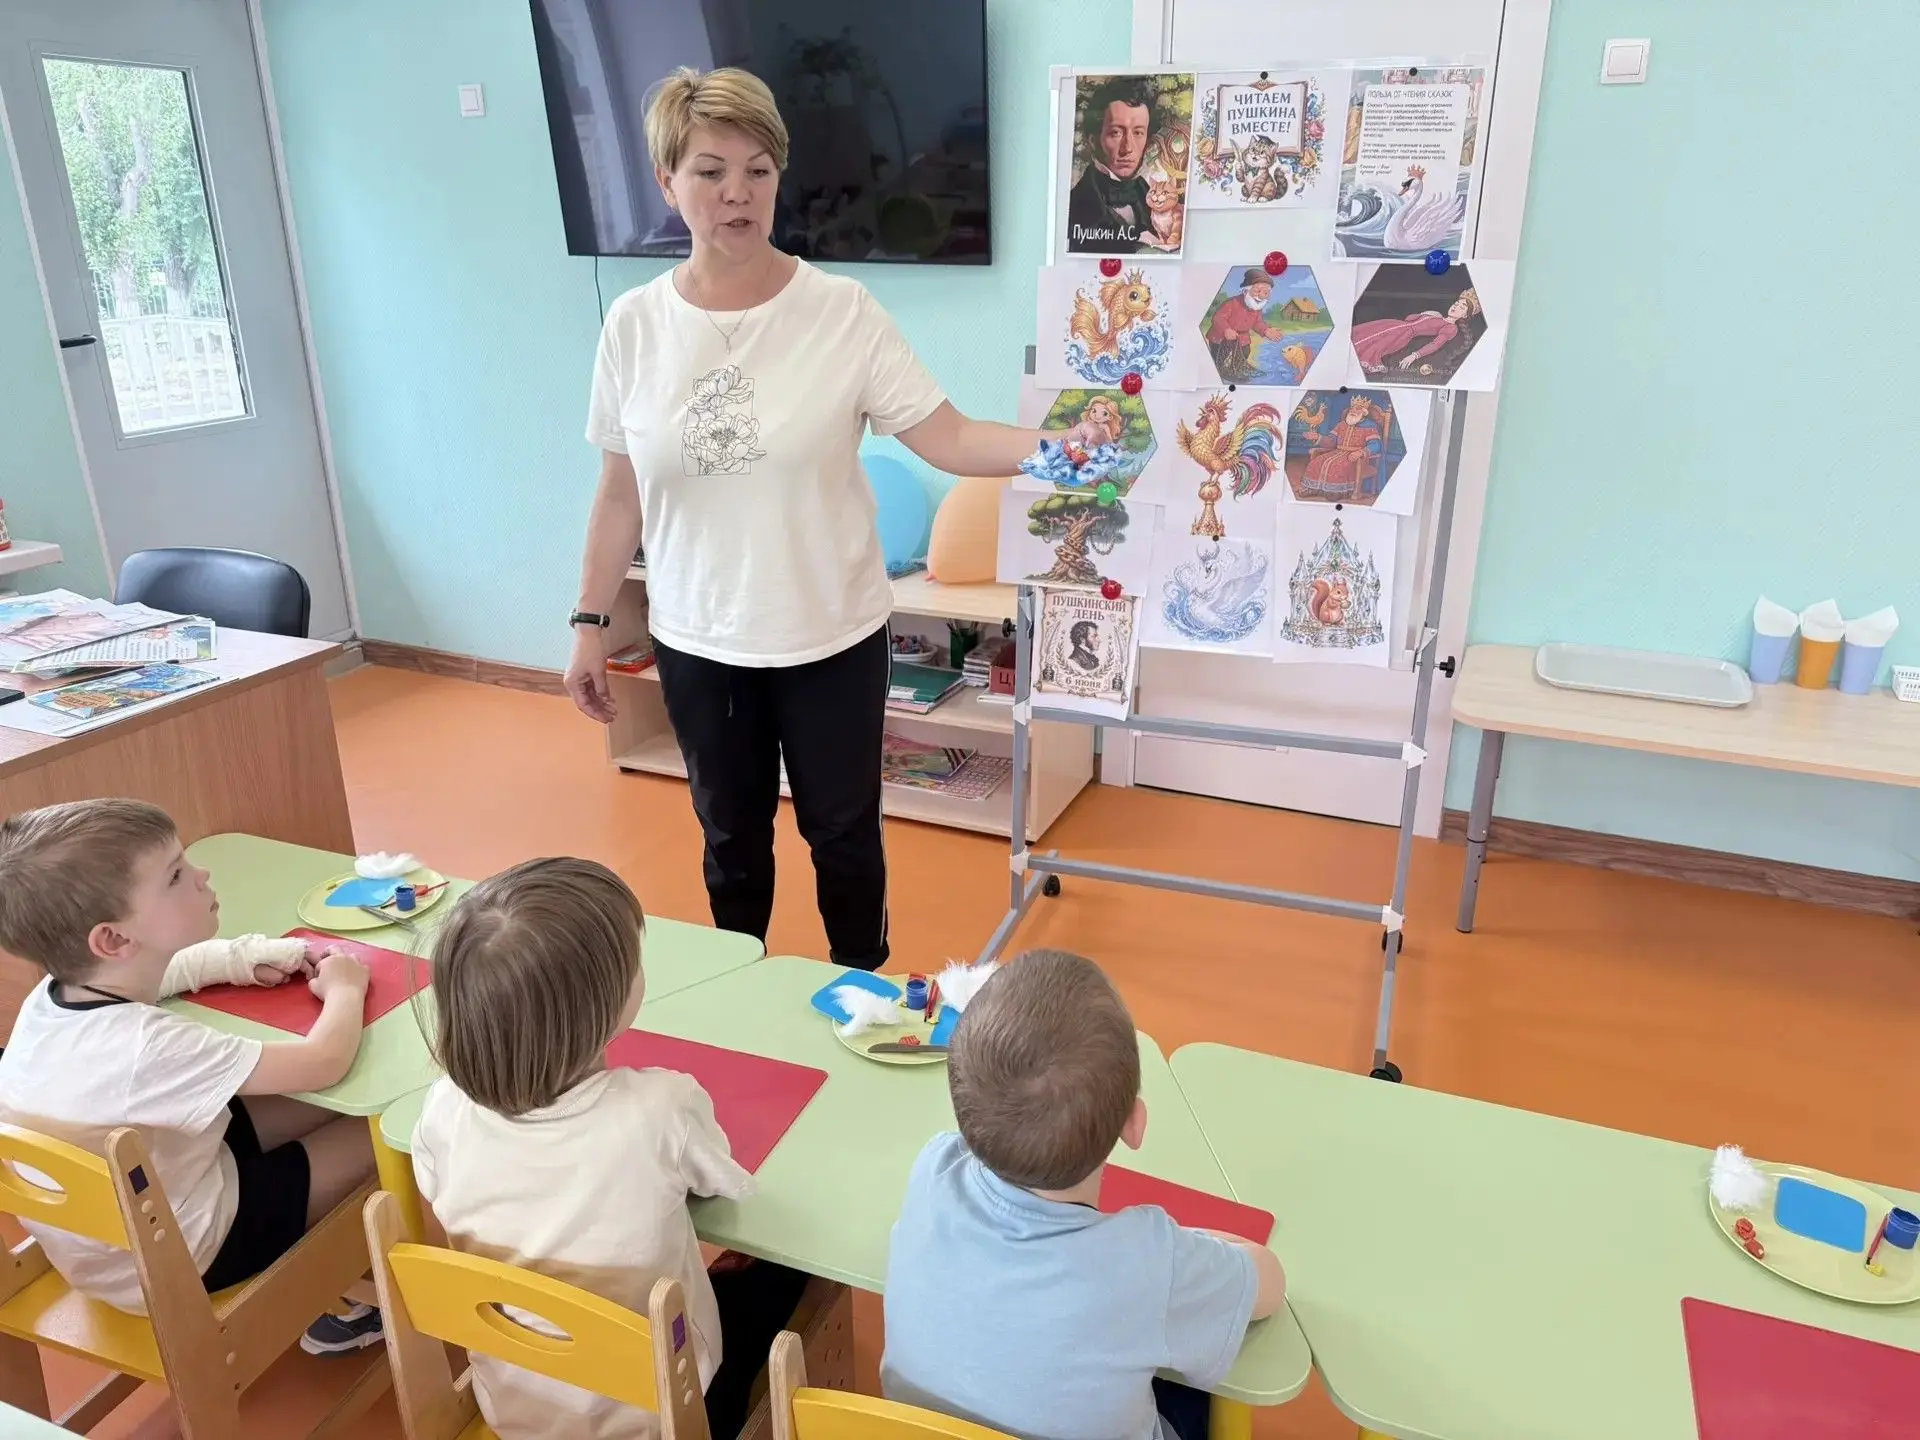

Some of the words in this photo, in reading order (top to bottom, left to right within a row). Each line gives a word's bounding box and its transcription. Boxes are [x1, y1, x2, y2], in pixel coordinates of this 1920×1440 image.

[1234, 92, 1292, 105] ЧИТАЕМ
[1367, 90, 1392, 99] ПОЛЬЗА
[1394, 90, 1402, 98] ОТ
[1403, 90, 1427, 98] ЧТЕНИЯ
[1427, 90, 1453, 98] СКАЗОК
[1227, 107, 1297, 121] ПУШКИНА
[1231, 121, 1292, 135] ВМЕСТЕ!
[1073, 224, 1115, 245] Пушкин
[1116, 225, 1138, 241] А.С.
[1052, 595, 1127, 613] ПУШКИНСКИЙ
[1072, 608, 1105, 621] ДЕНЬ
[1065, 677, 1072, 685] 6
